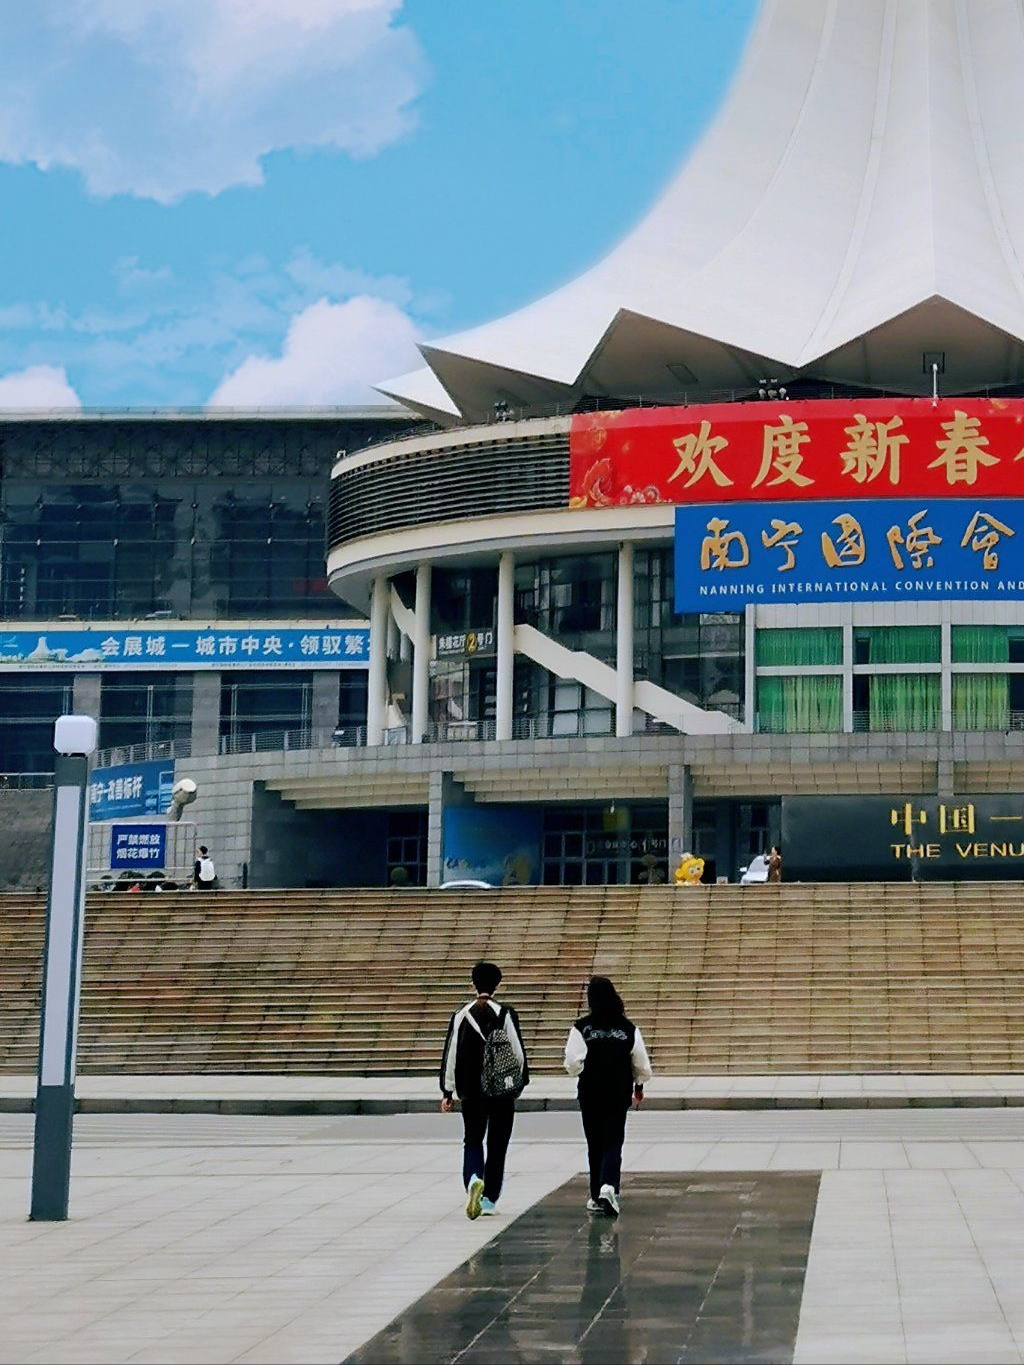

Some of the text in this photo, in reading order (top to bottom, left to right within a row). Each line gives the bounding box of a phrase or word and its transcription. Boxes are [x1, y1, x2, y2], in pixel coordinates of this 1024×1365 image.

[700, 584, 764, 595] NANNING
[772, 581, 887, 594] INTERNATIONAL
[895, 581, 989, 591] CONVENTION
[890, 843, 941, 858] THE
